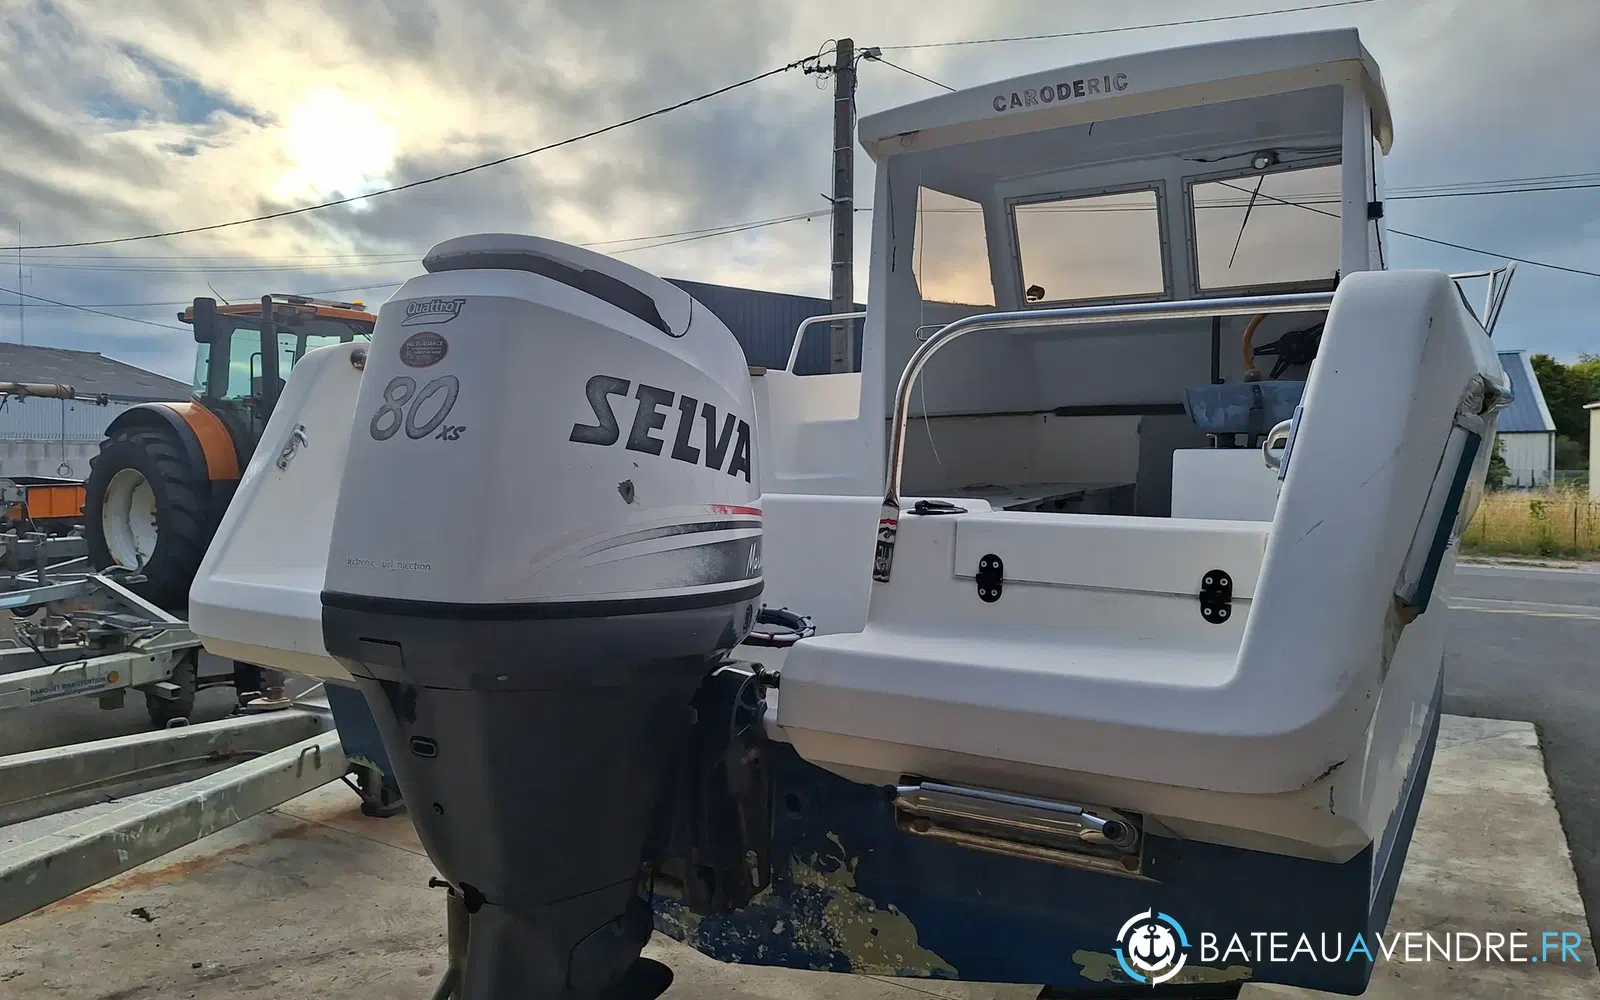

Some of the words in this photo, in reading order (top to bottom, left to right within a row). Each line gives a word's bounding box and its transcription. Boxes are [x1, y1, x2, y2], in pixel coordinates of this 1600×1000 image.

[992, 73, 1129, 112] CARODERIC
[369, 375, 460, 441] 80
[568, 374, 751, 484] SELVA
